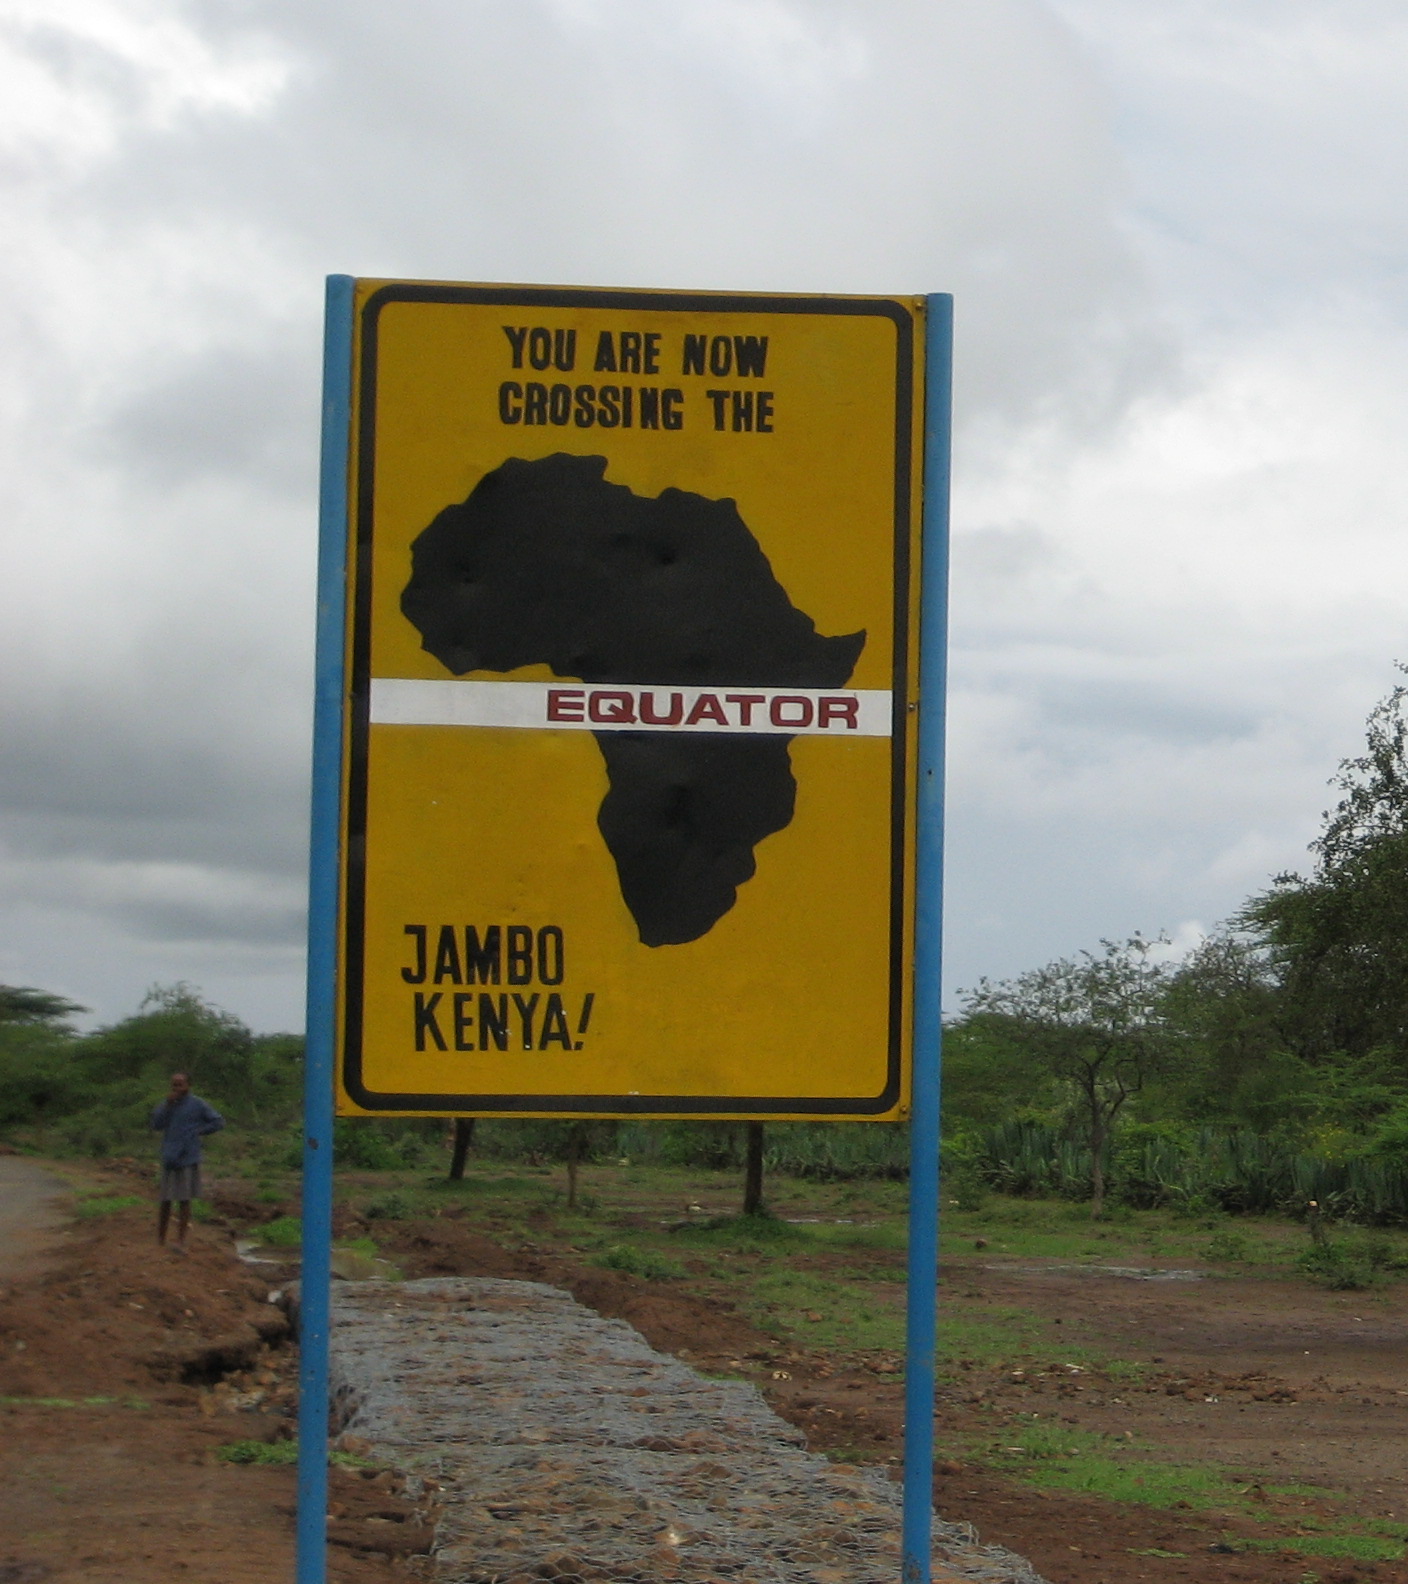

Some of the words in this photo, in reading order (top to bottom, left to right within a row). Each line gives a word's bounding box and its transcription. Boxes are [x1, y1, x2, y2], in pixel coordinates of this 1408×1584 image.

[501, 326, 577, 372] YOU
[594, 331, 663, 375] ARE
[683, 334, 769, 378] NOW
[499, 381, 684, 430] CROSSING
[707, 389, 774, 433] THE
[547, 689, 860, 729] EQUATOR
[401, 924, 565, 986] JAMBO
[414, 992, 595, 1052] KENYA!
